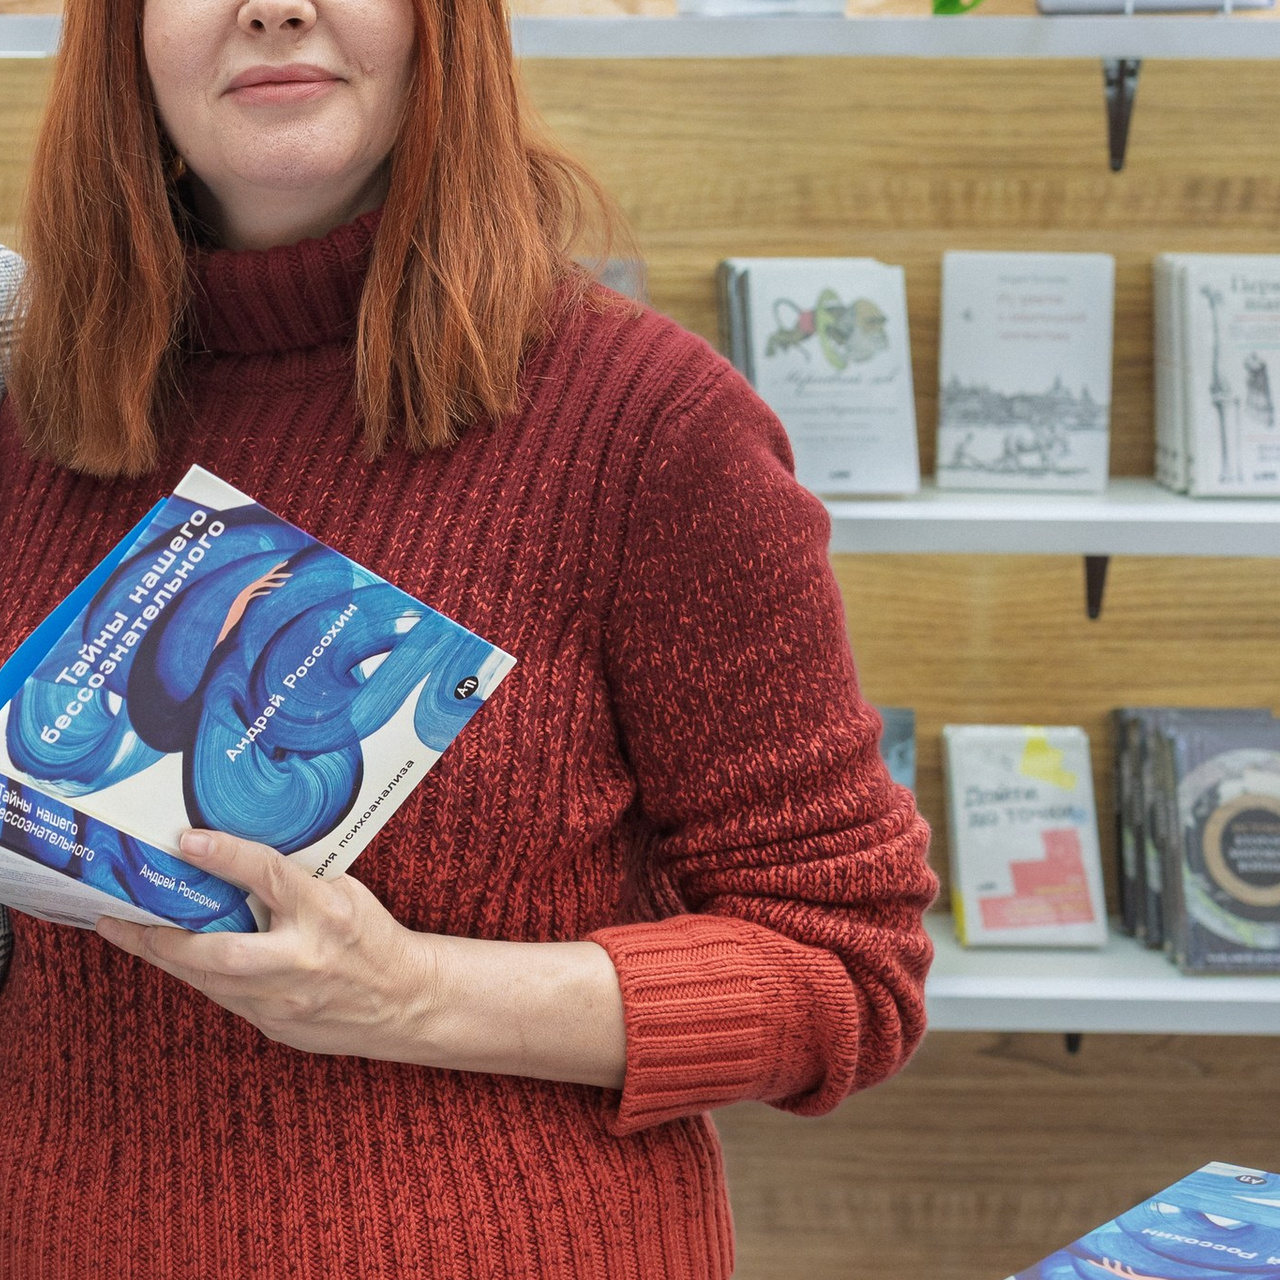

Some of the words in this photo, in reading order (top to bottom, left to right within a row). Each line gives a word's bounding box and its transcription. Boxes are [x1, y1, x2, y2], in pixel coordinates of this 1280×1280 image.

[40, 520, 225, 744] бессознательного
[55, 611, 129, 686] Тайны
[128, 509, 207, 604] нашего
[225, 693, 286, 762] Андрей
[282, 603, 358, 689] Россохин
[36, 806, 79, 835] нашего
[339, 759, 414, 848] психоанализа
[139, 863, 177, 892] Андрей
[177, 880, 221, 912] Россохин
[1141, 1228, 1259, 1260] Россохин
